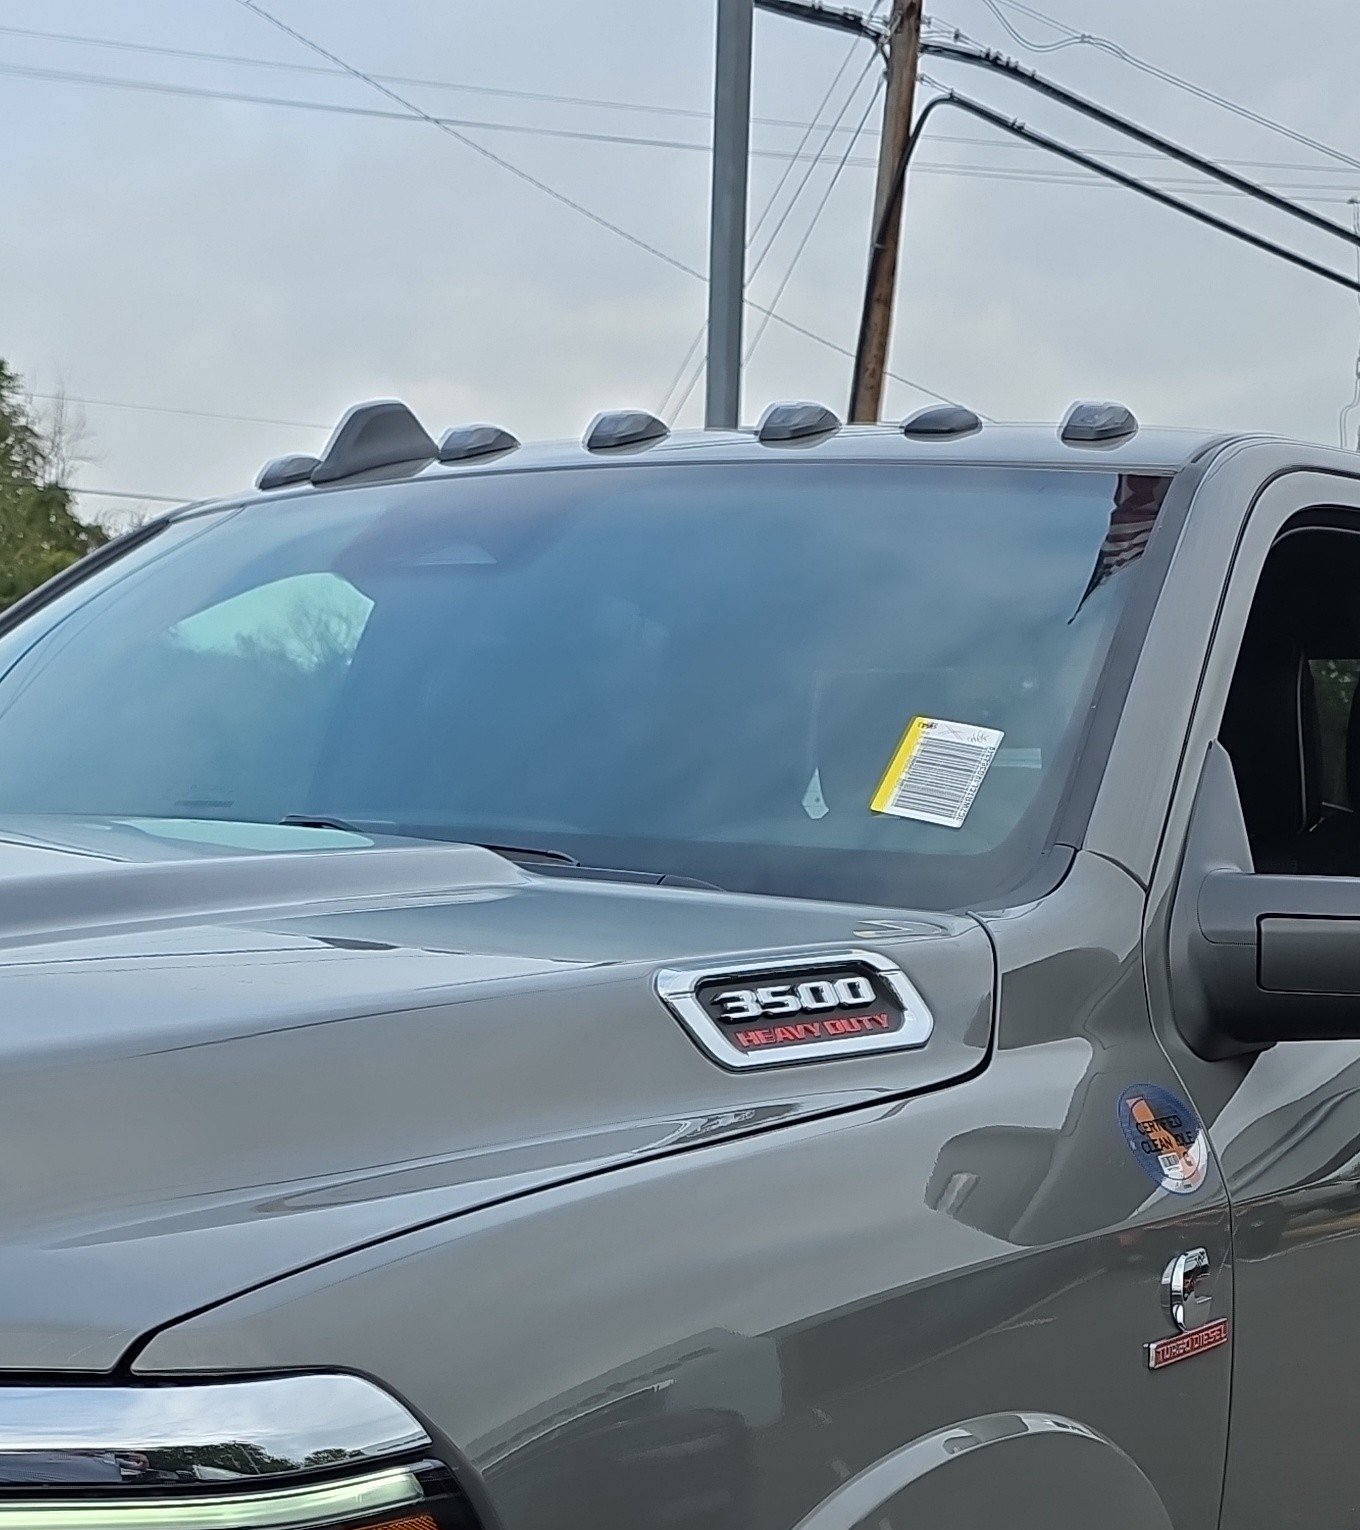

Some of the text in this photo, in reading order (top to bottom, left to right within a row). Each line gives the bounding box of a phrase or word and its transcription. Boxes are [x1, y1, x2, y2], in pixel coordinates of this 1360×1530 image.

[712, 975, 877, 1023] 3500
[737, 1013, 889, 1047] HEAVY DUTY
[1136, 1114, 1183, 1136] CERTIFIED
[1141, 1130, 1196, 1155] CLEAN IDLE
[1155, 1323, 1228, 1362] TURBO DIESEL
